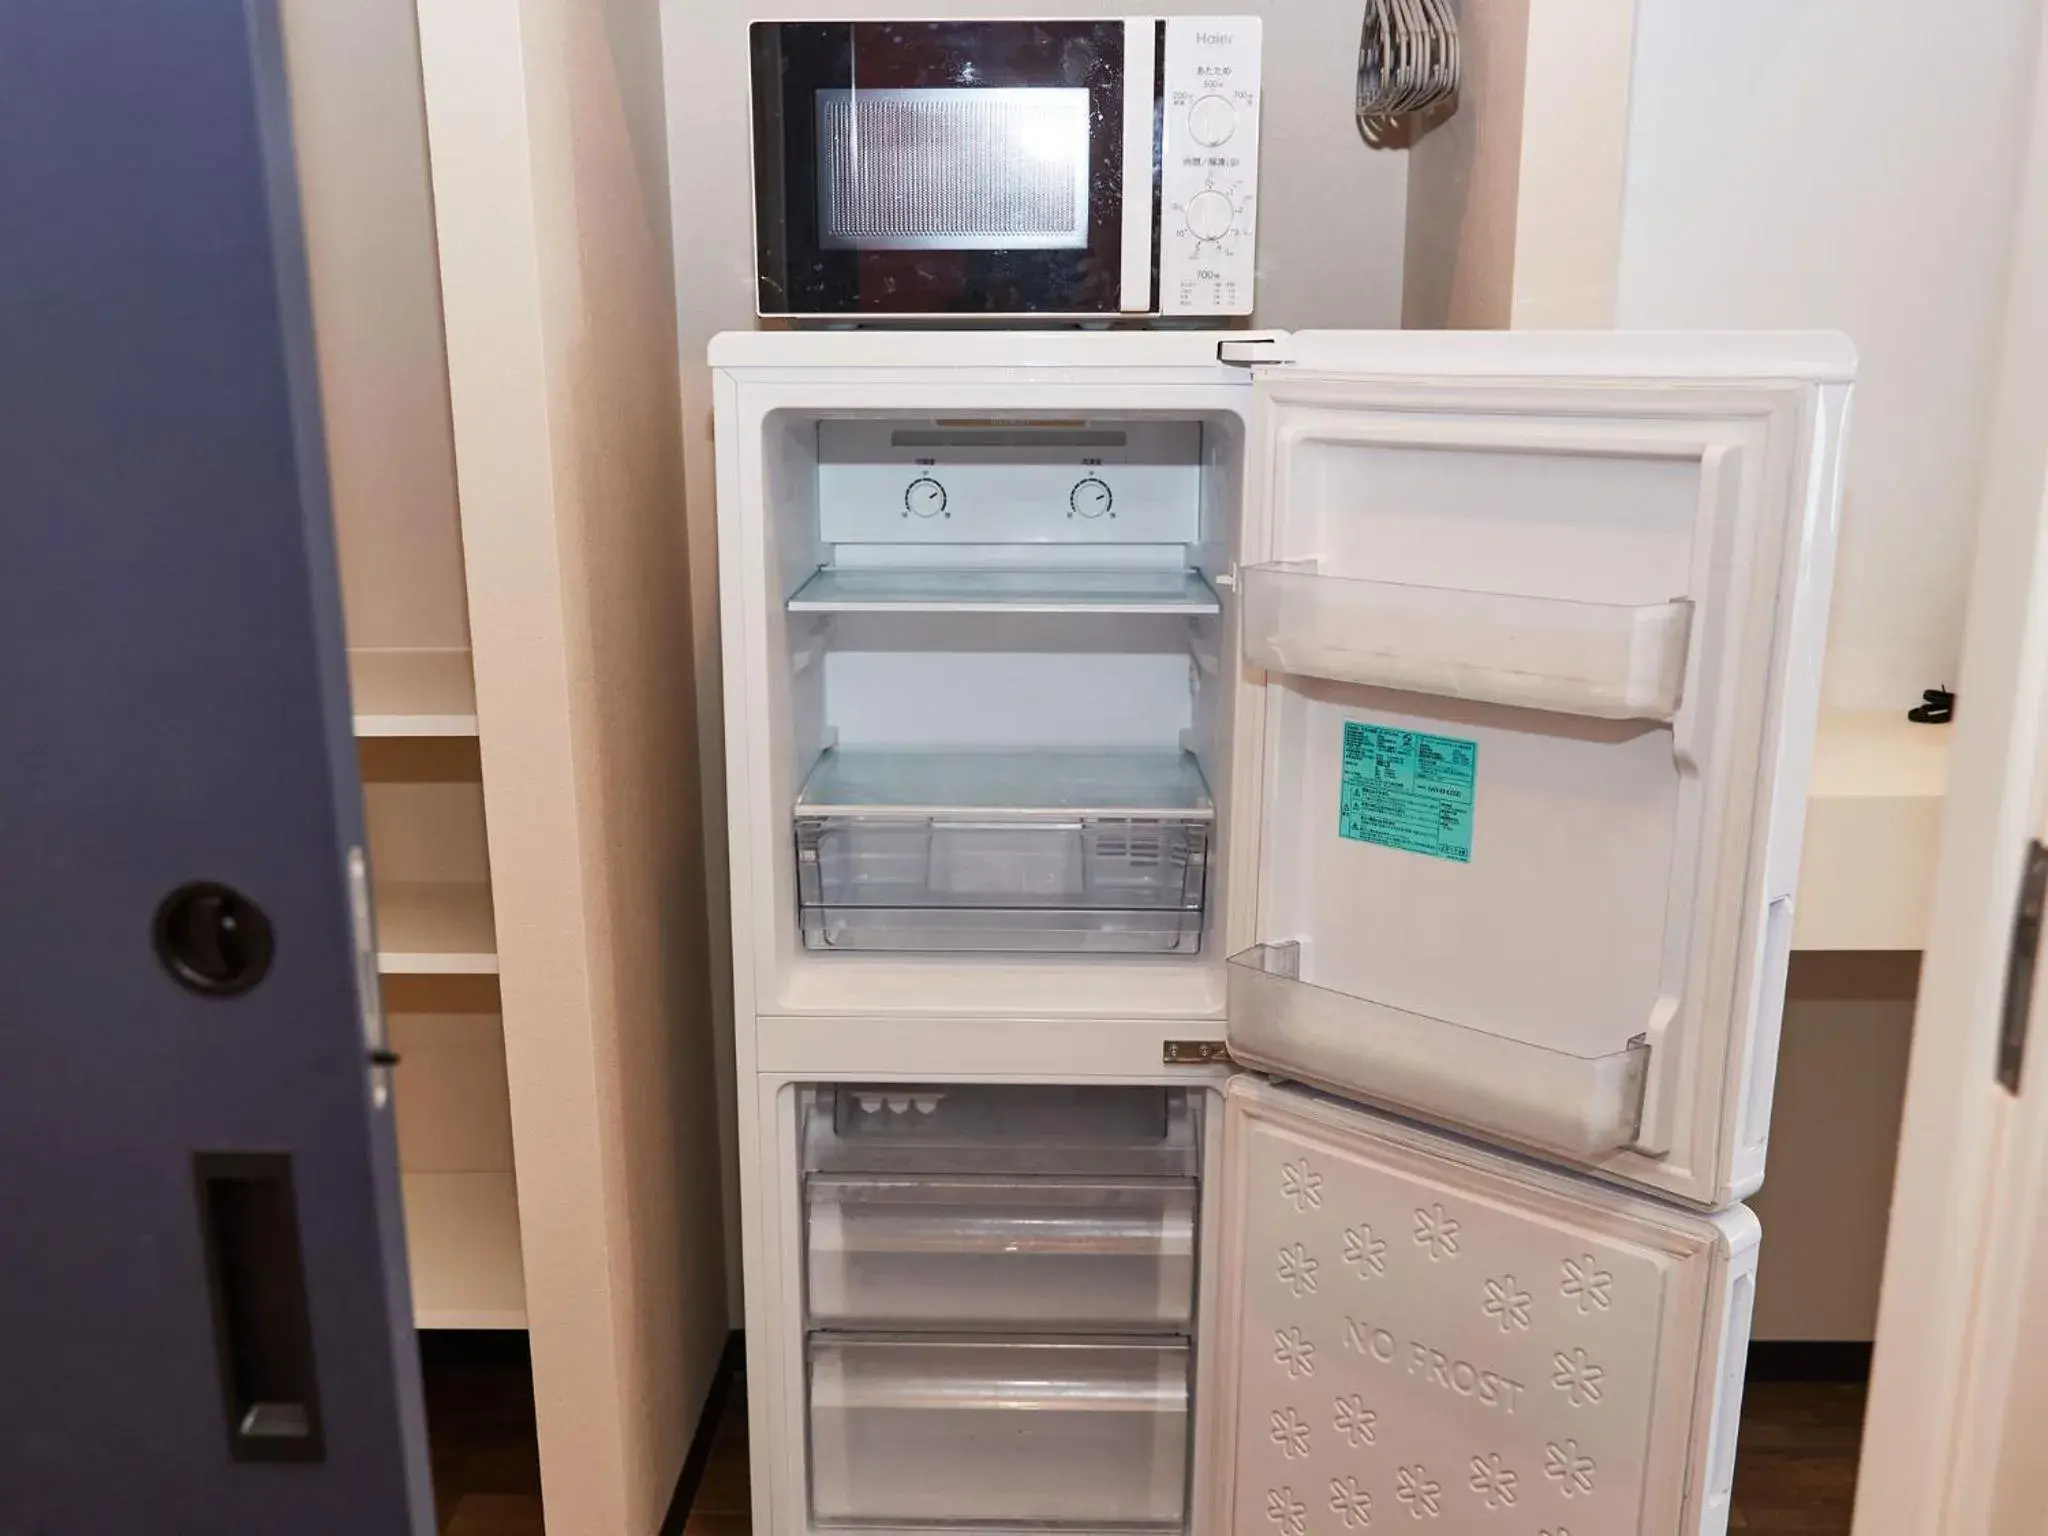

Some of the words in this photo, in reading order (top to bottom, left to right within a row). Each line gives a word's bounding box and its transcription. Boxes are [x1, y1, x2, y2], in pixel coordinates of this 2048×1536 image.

[1196, 32, 1232, 45] Haier
[1342, 1314, 1396, 1364] NO
[1406, 1340, 1526, 1414] FROST
